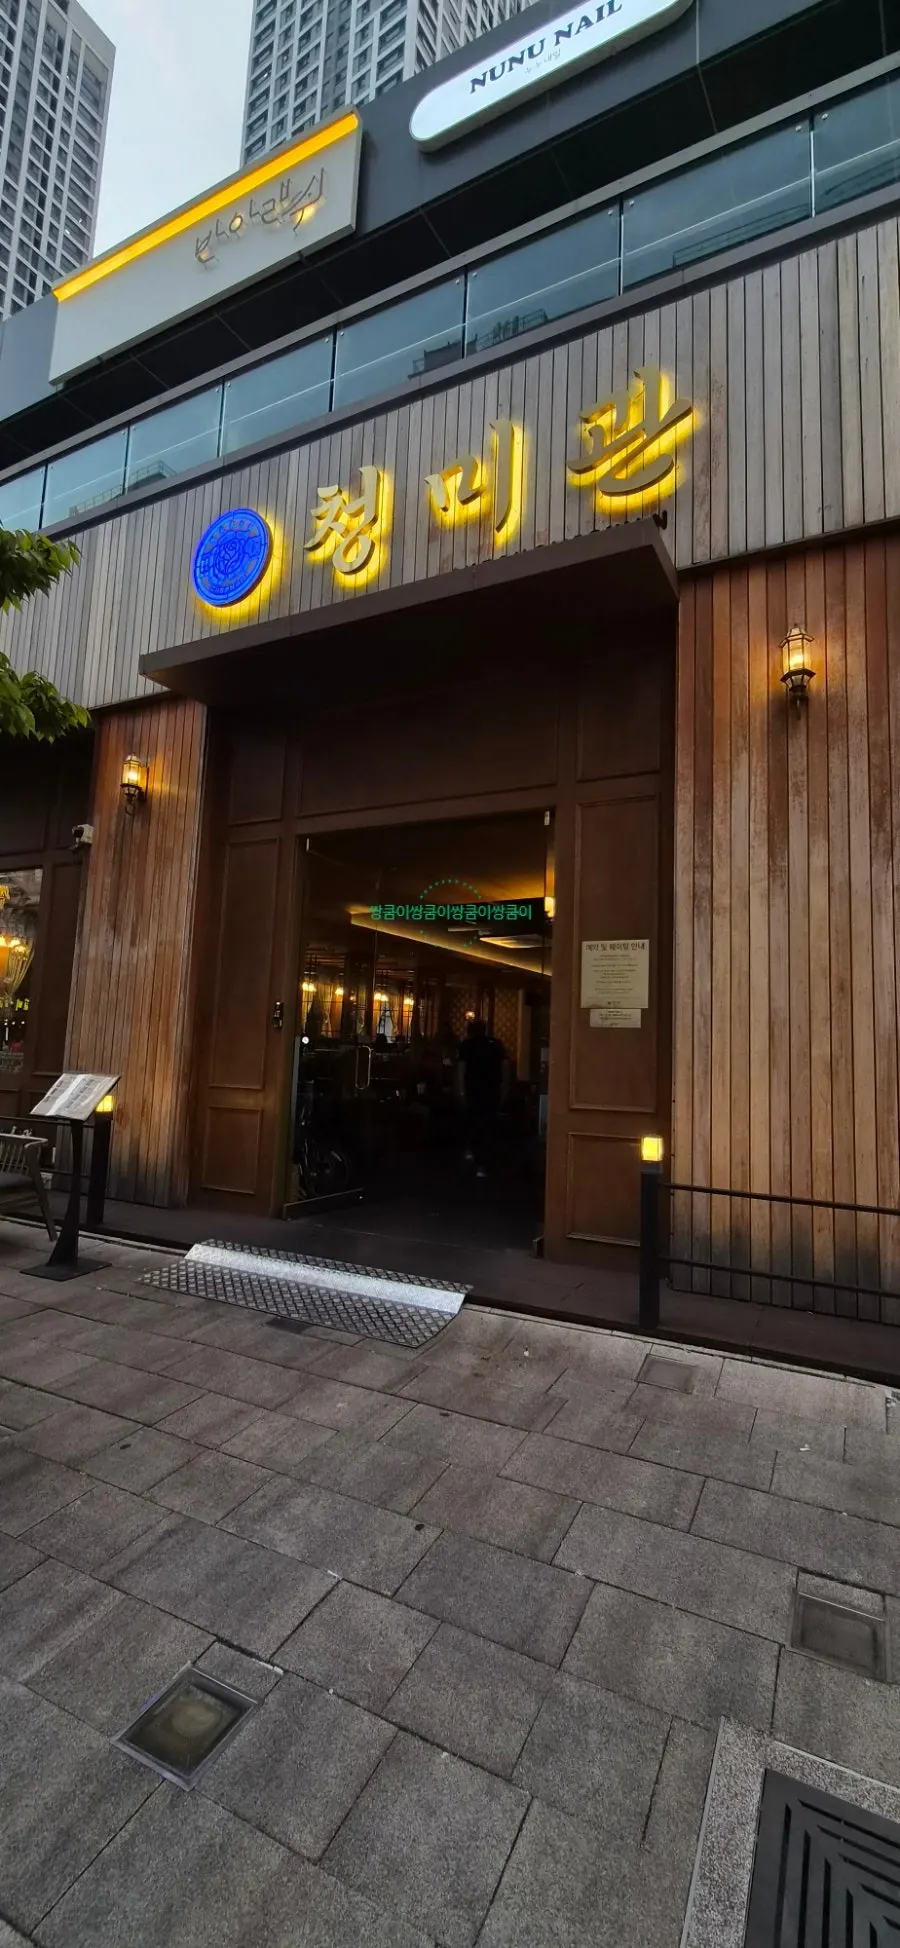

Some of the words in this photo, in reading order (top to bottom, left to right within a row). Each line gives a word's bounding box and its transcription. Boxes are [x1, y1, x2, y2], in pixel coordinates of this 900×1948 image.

[469, 38, 546, 94] NUNU
[553, 0, 622, 46] NAIL
[303, 366, 693, 574] 청미관
[630, 941, 645, 951] 안내
